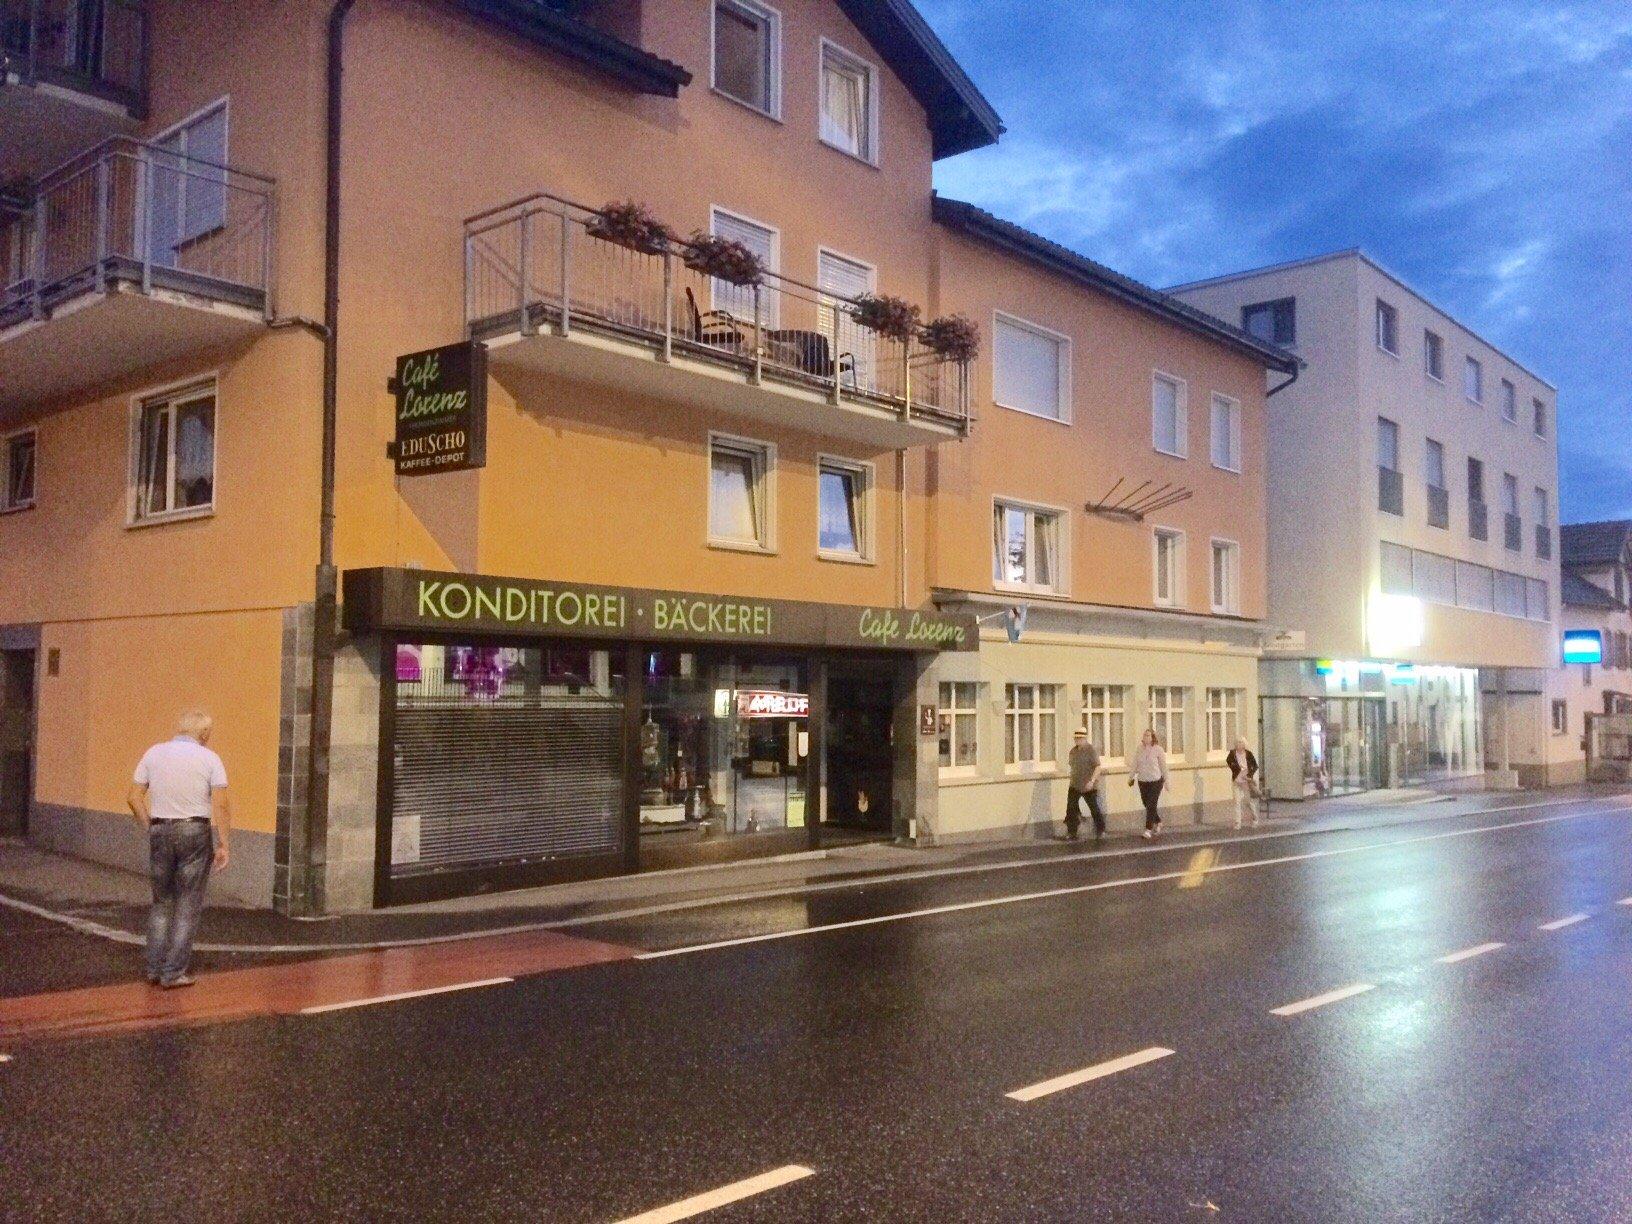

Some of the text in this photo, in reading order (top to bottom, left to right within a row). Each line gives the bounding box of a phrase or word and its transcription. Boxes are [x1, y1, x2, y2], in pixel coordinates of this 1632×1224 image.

[402, 353, 440, 390] Café
[399, 388, 467, 420] Lorenz
[401, 430, 466, 456] EDUSCHO
[418, 580, 771, 635] KONDITOREI BÄCKEREI
[905, 611, 966, 642] Lorenz
